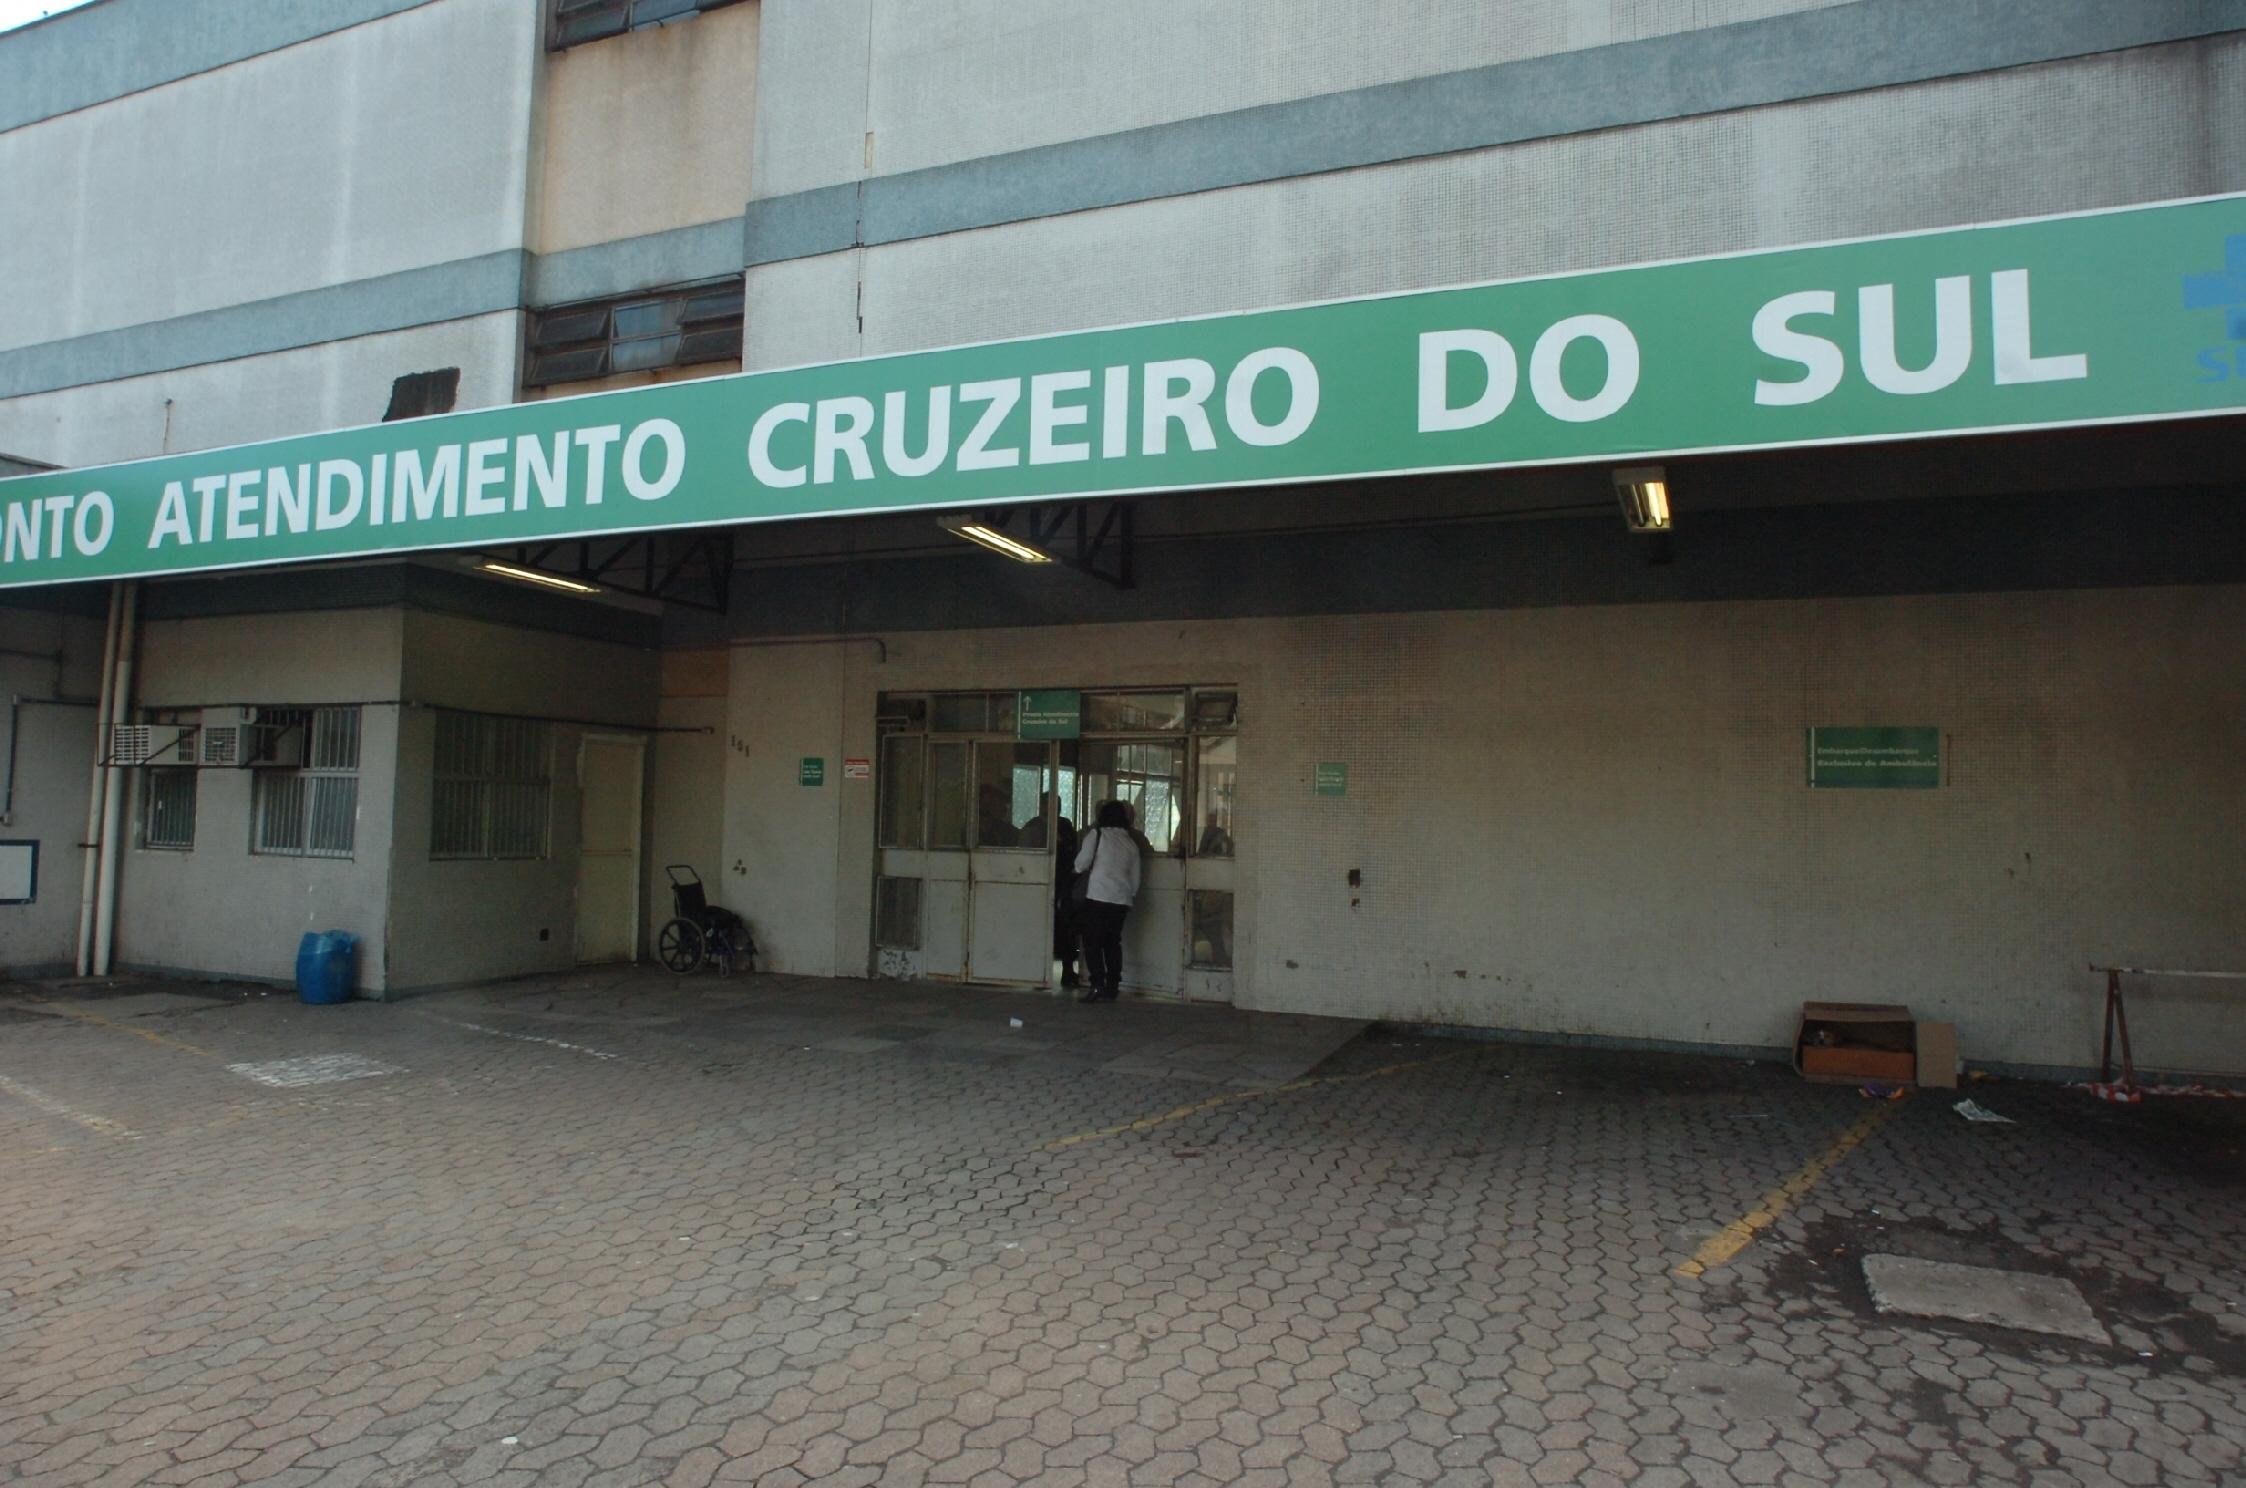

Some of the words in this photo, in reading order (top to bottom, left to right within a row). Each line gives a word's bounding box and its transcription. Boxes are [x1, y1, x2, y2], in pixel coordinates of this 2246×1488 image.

[0, 491, 114, 562] NTO
[147, 418, 686, 549] ATENDIMENTO
[747, 346, 1320, 488] CRUZEIRO
[1418, 313, 1640, 433] DO
[1751, 268, 2088, 406] SUL
